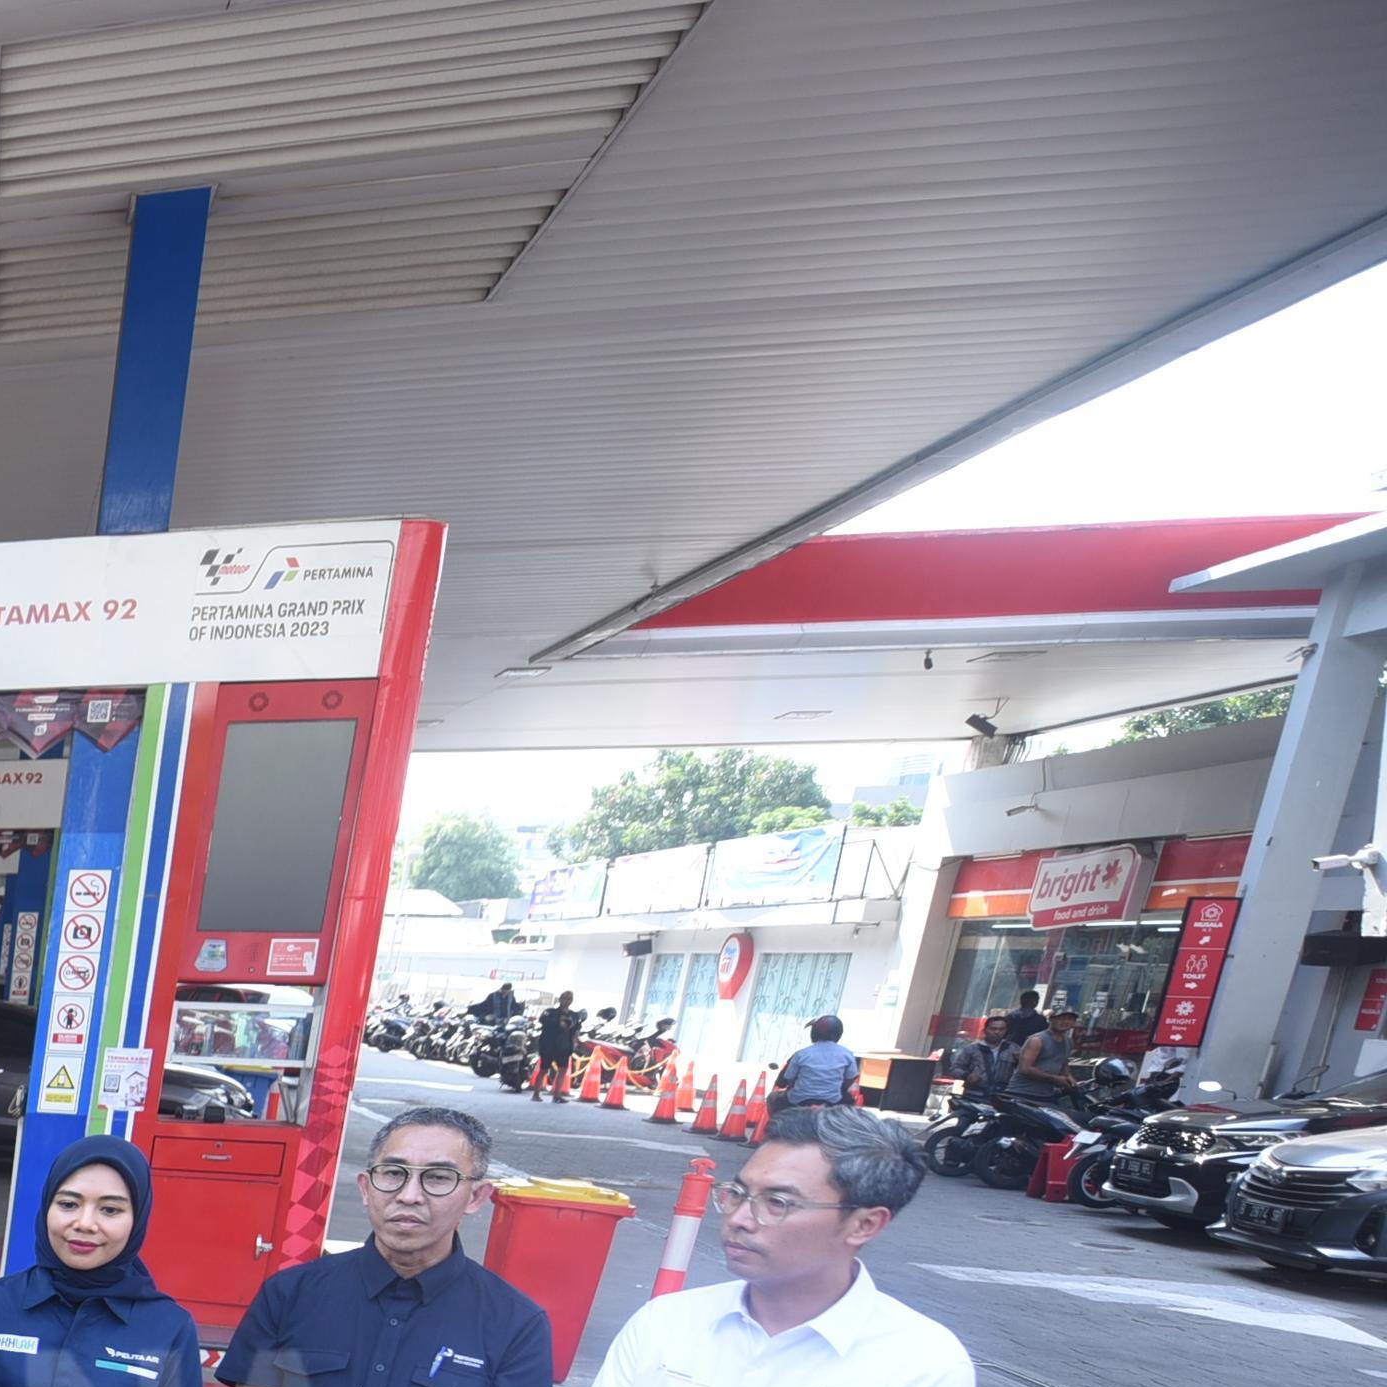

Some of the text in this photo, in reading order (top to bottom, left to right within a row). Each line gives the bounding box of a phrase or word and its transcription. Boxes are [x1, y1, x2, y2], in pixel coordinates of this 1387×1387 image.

[303, 566, 373, 580] PERTAMINA
[102, 598, 138, 621] 92
[191, 599, 365, 621] PERTAMINA GRAND PRIX
[189, 621, 330, 641] OF INDONESIA 2023
[25, 772, 44, 785] 92
[1035, 863, 1102, 902] bright
[1053, 904, 1109, 921] food and drink
[115, 1351, 160, 1364] PELITA AIR
